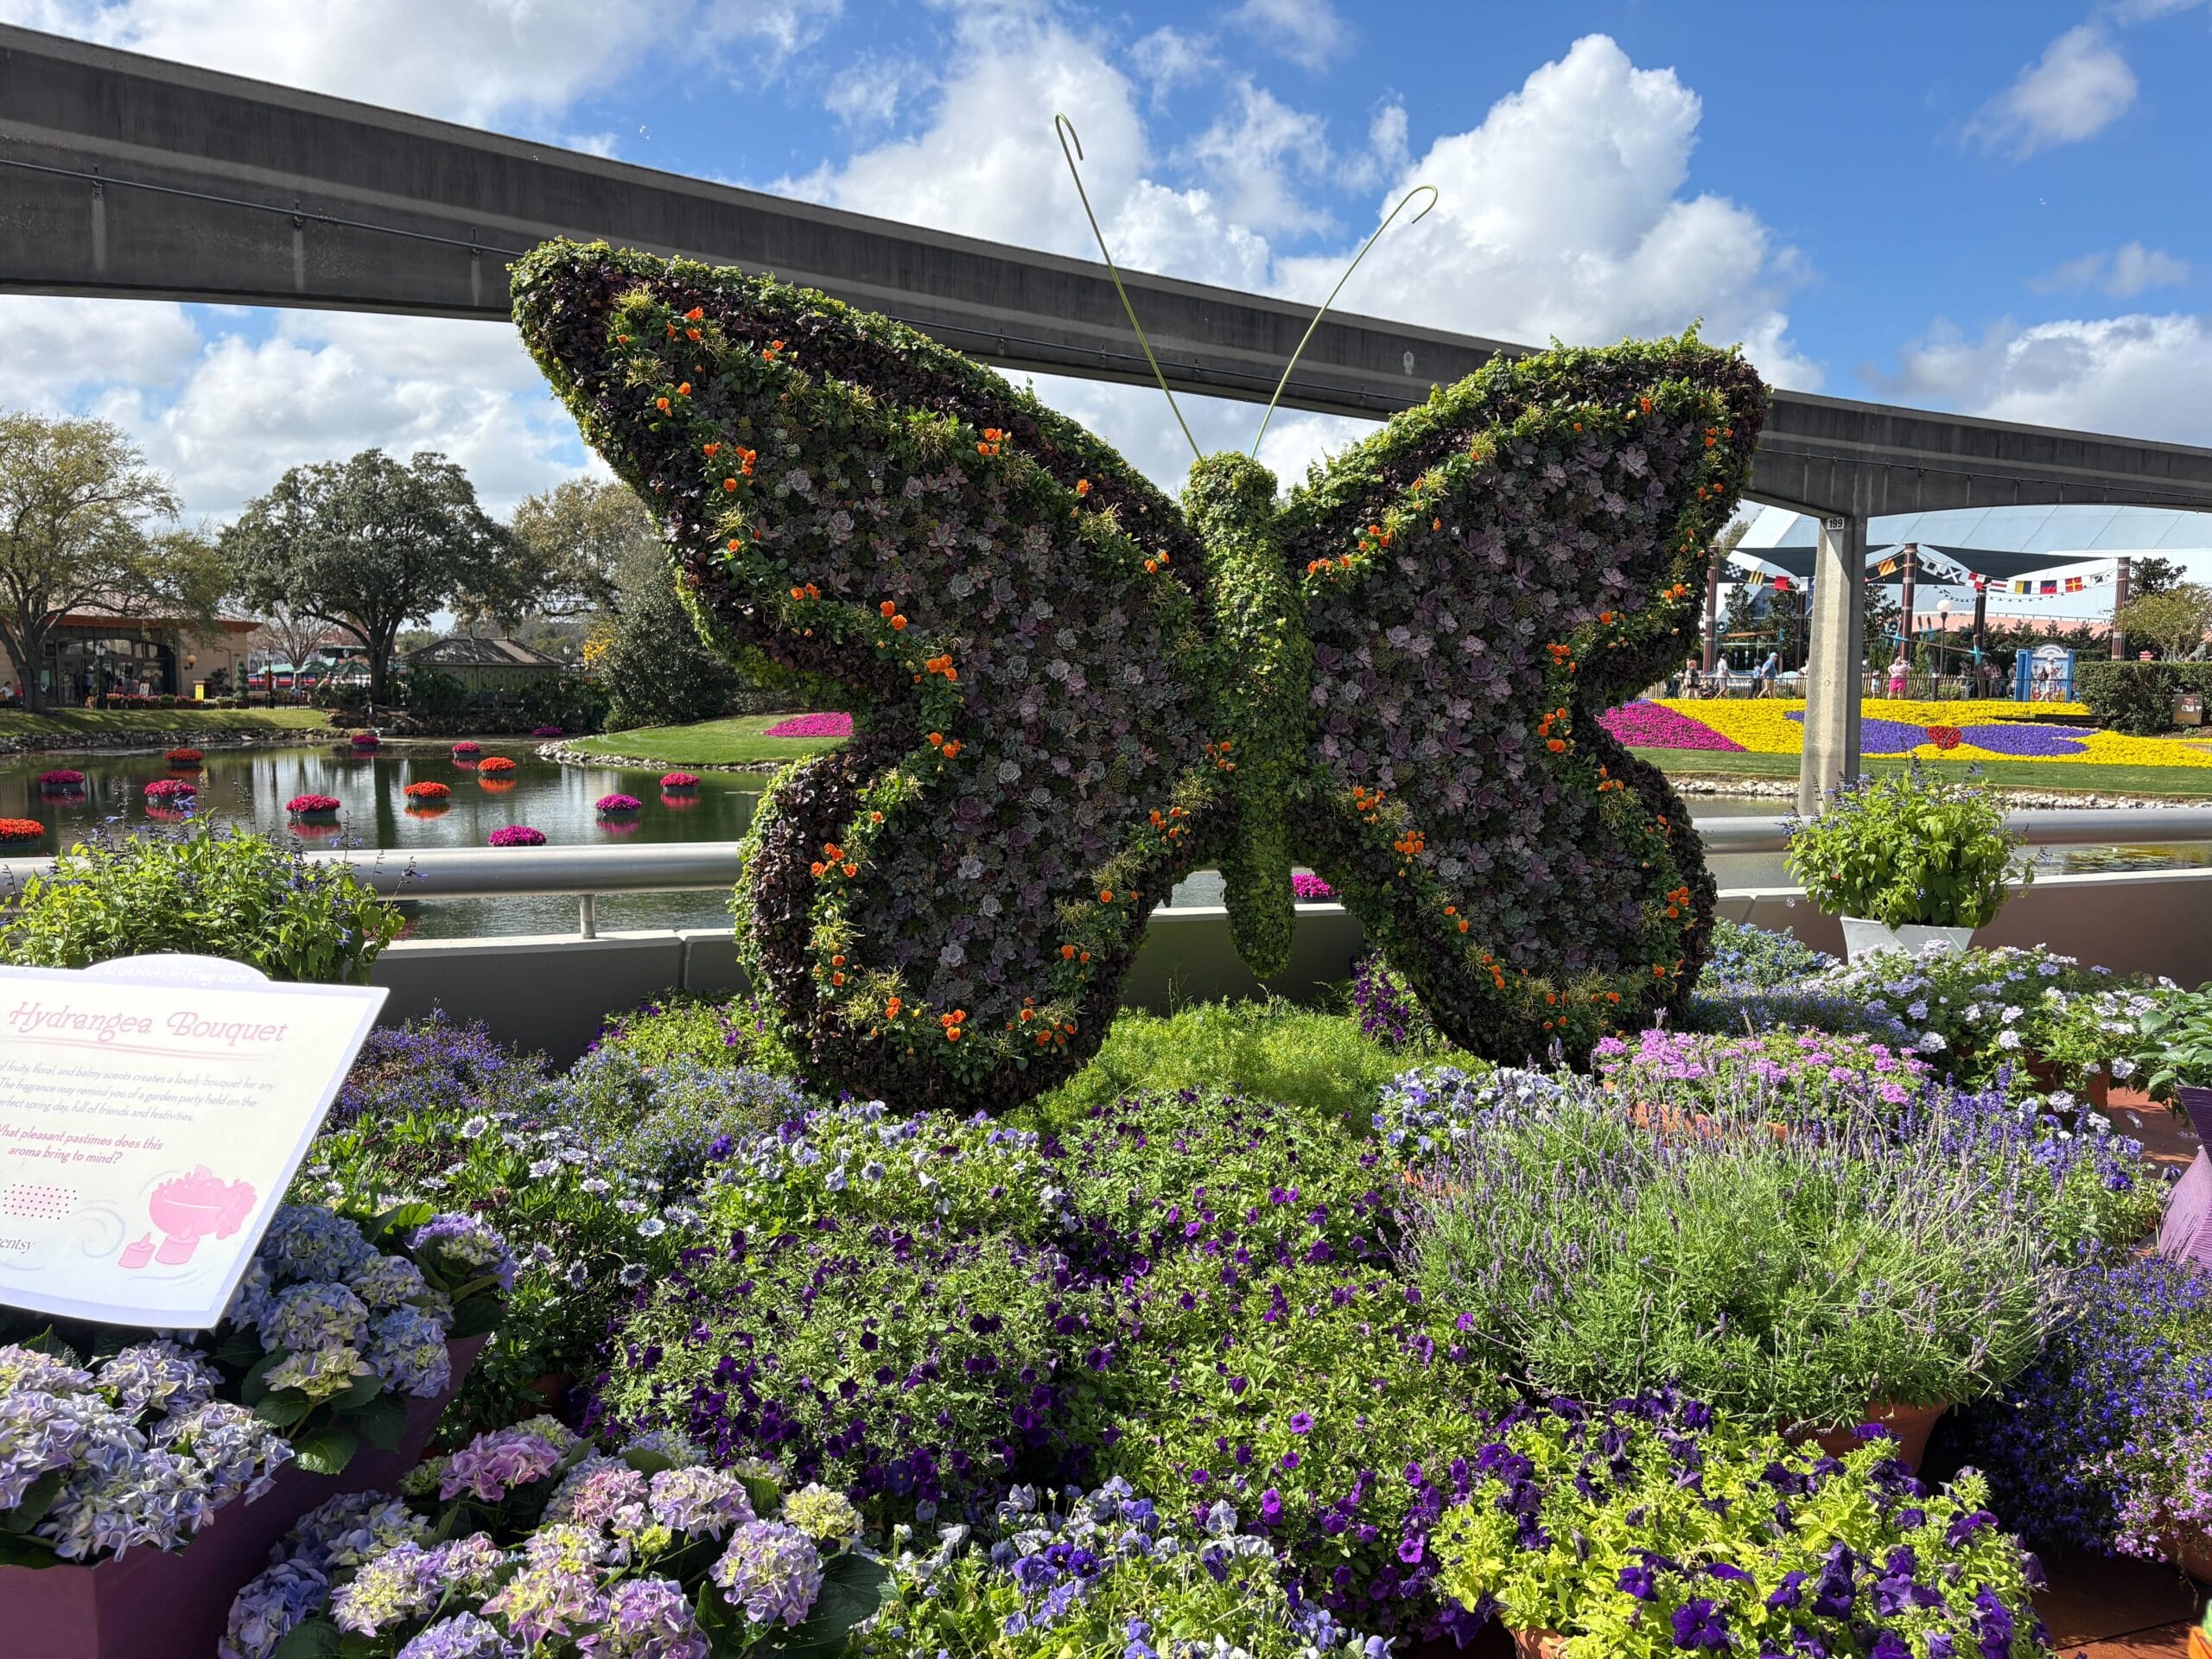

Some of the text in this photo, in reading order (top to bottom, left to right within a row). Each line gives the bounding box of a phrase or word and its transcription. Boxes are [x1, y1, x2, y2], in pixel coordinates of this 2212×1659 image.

[1829, 518, 1843, 528] 199
[8, 1001, 290, 1046] Hydrangea Bouquet
[58, 1065, 78, 1077] and
[76, 1065, 101, 1080] balmy
[103, 1072, 131, 1082] scents
[132, 1072, 167, 1084] creates
[175, 1072, 200, 1088] lovely
[202, 1073, 243, 1090] bouquet
[244, 1075, 257, 1089] for
[257, 1080, 276, 1093] any
[0, 1077, 15, 1090] The
[16, 1077, 56, 1094] fragrance
[57, 1085, 76, 1096] may
[76, 1085, 111, 1097] remind
[108, 1090, 126, 1099] you
[126, 1086, 142, 1099] of
[143, 1090, 178, 1103] garden
[177, 1093, 204, 1107] party
[204, 1092, 228, 1105] held
[227, 1097, 240, 1107] on
[241, 1094, 257, 1108] the
[26, 1100, 52, 1113] spring
[71, 1100, 90, 1113] full
[86, 1101, 101, 1114] of
[99, 1102, 130, 1116] friends
[130, 1106, 152, 1119] and
[18, 1124, 67, 1142] pleasant
[63, 1133, 113, 1147] pastimes
[114, 1134, 140, 1148] does
[142, 1136, 164, 1151] this
[8, 1144, 124, 1165] aroma bring to mind?
[0, 1238, 37, 1255] entsy
